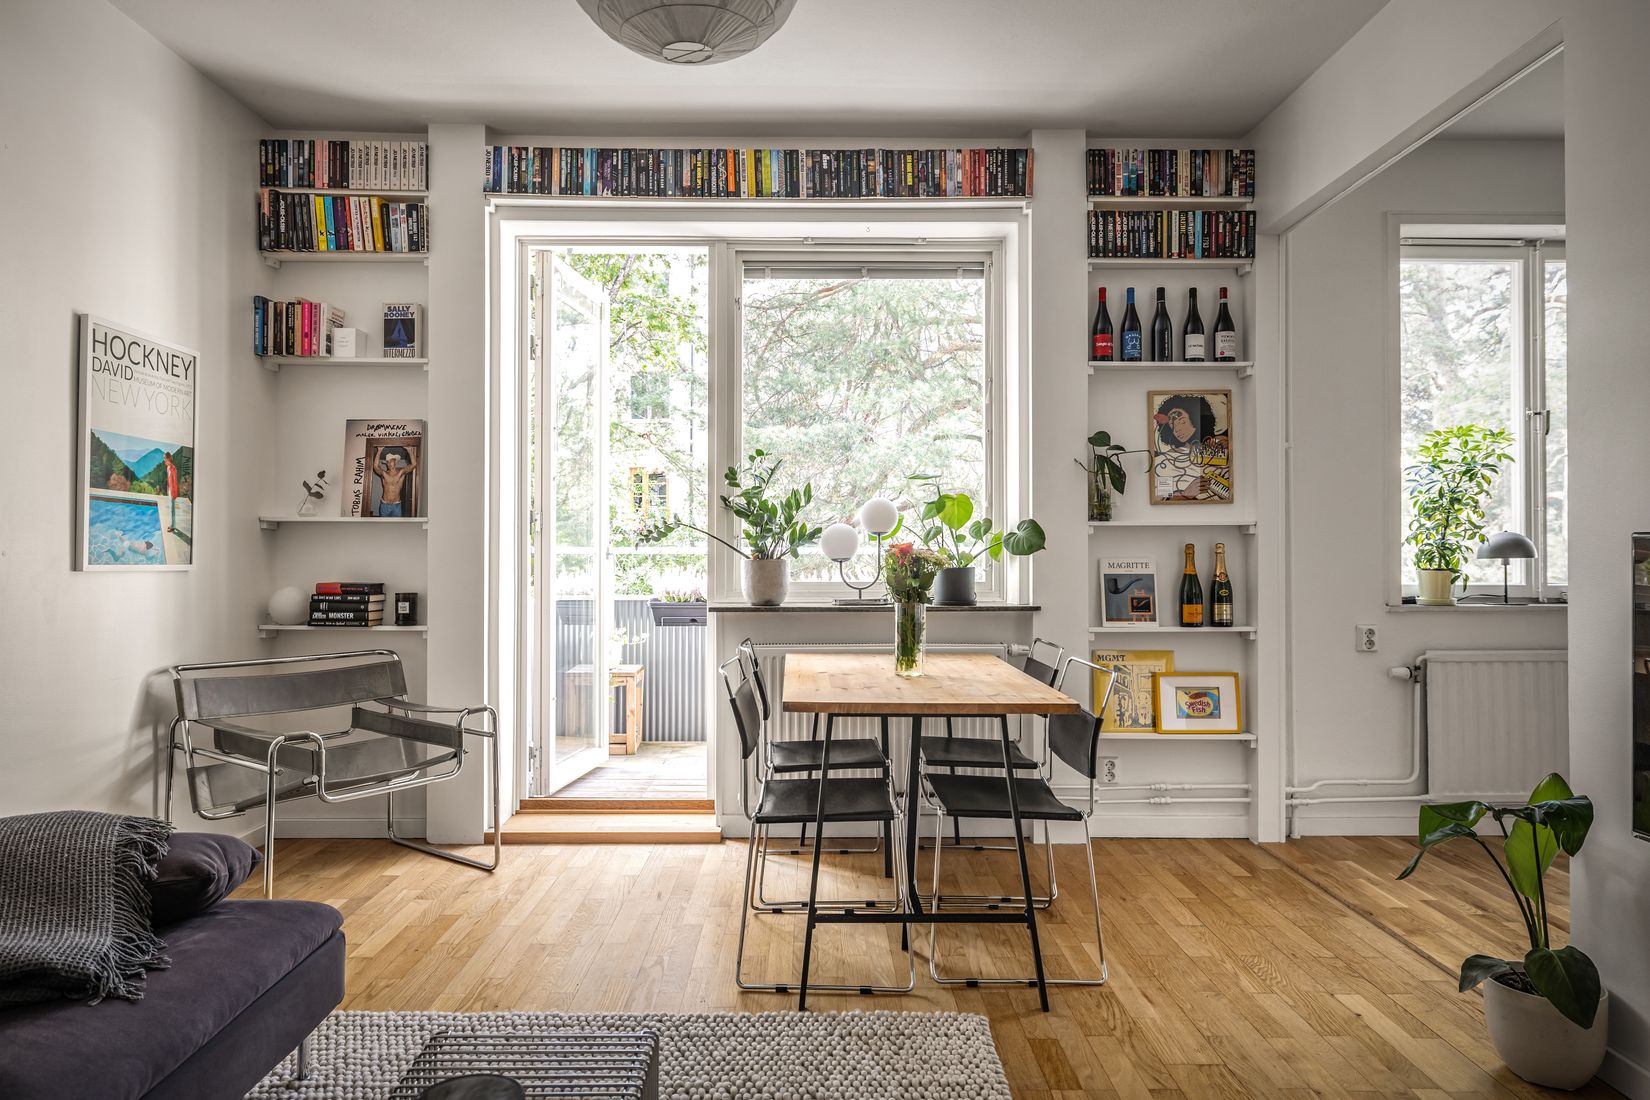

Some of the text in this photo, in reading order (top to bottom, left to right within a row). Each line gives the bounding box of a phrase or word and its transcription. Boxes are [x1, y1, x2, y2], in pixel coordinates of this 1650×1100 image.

[92, 328, 192, 380] HOCKNEY
[384, 348, 415, 358] INTERMEZZO
[92, 356, 133, 381] DAVID
[134, 376, 155, 386] MUSEUM
[163, 384, 183, 394] MODERN
[92, 374, 192, 421] NEW YORK
[367, 424, 407, 432] DRØMMENE
[351, 457, 365, 516] TOBIAS RAHIM
[1184, 700, 1211, 710] Swedish
